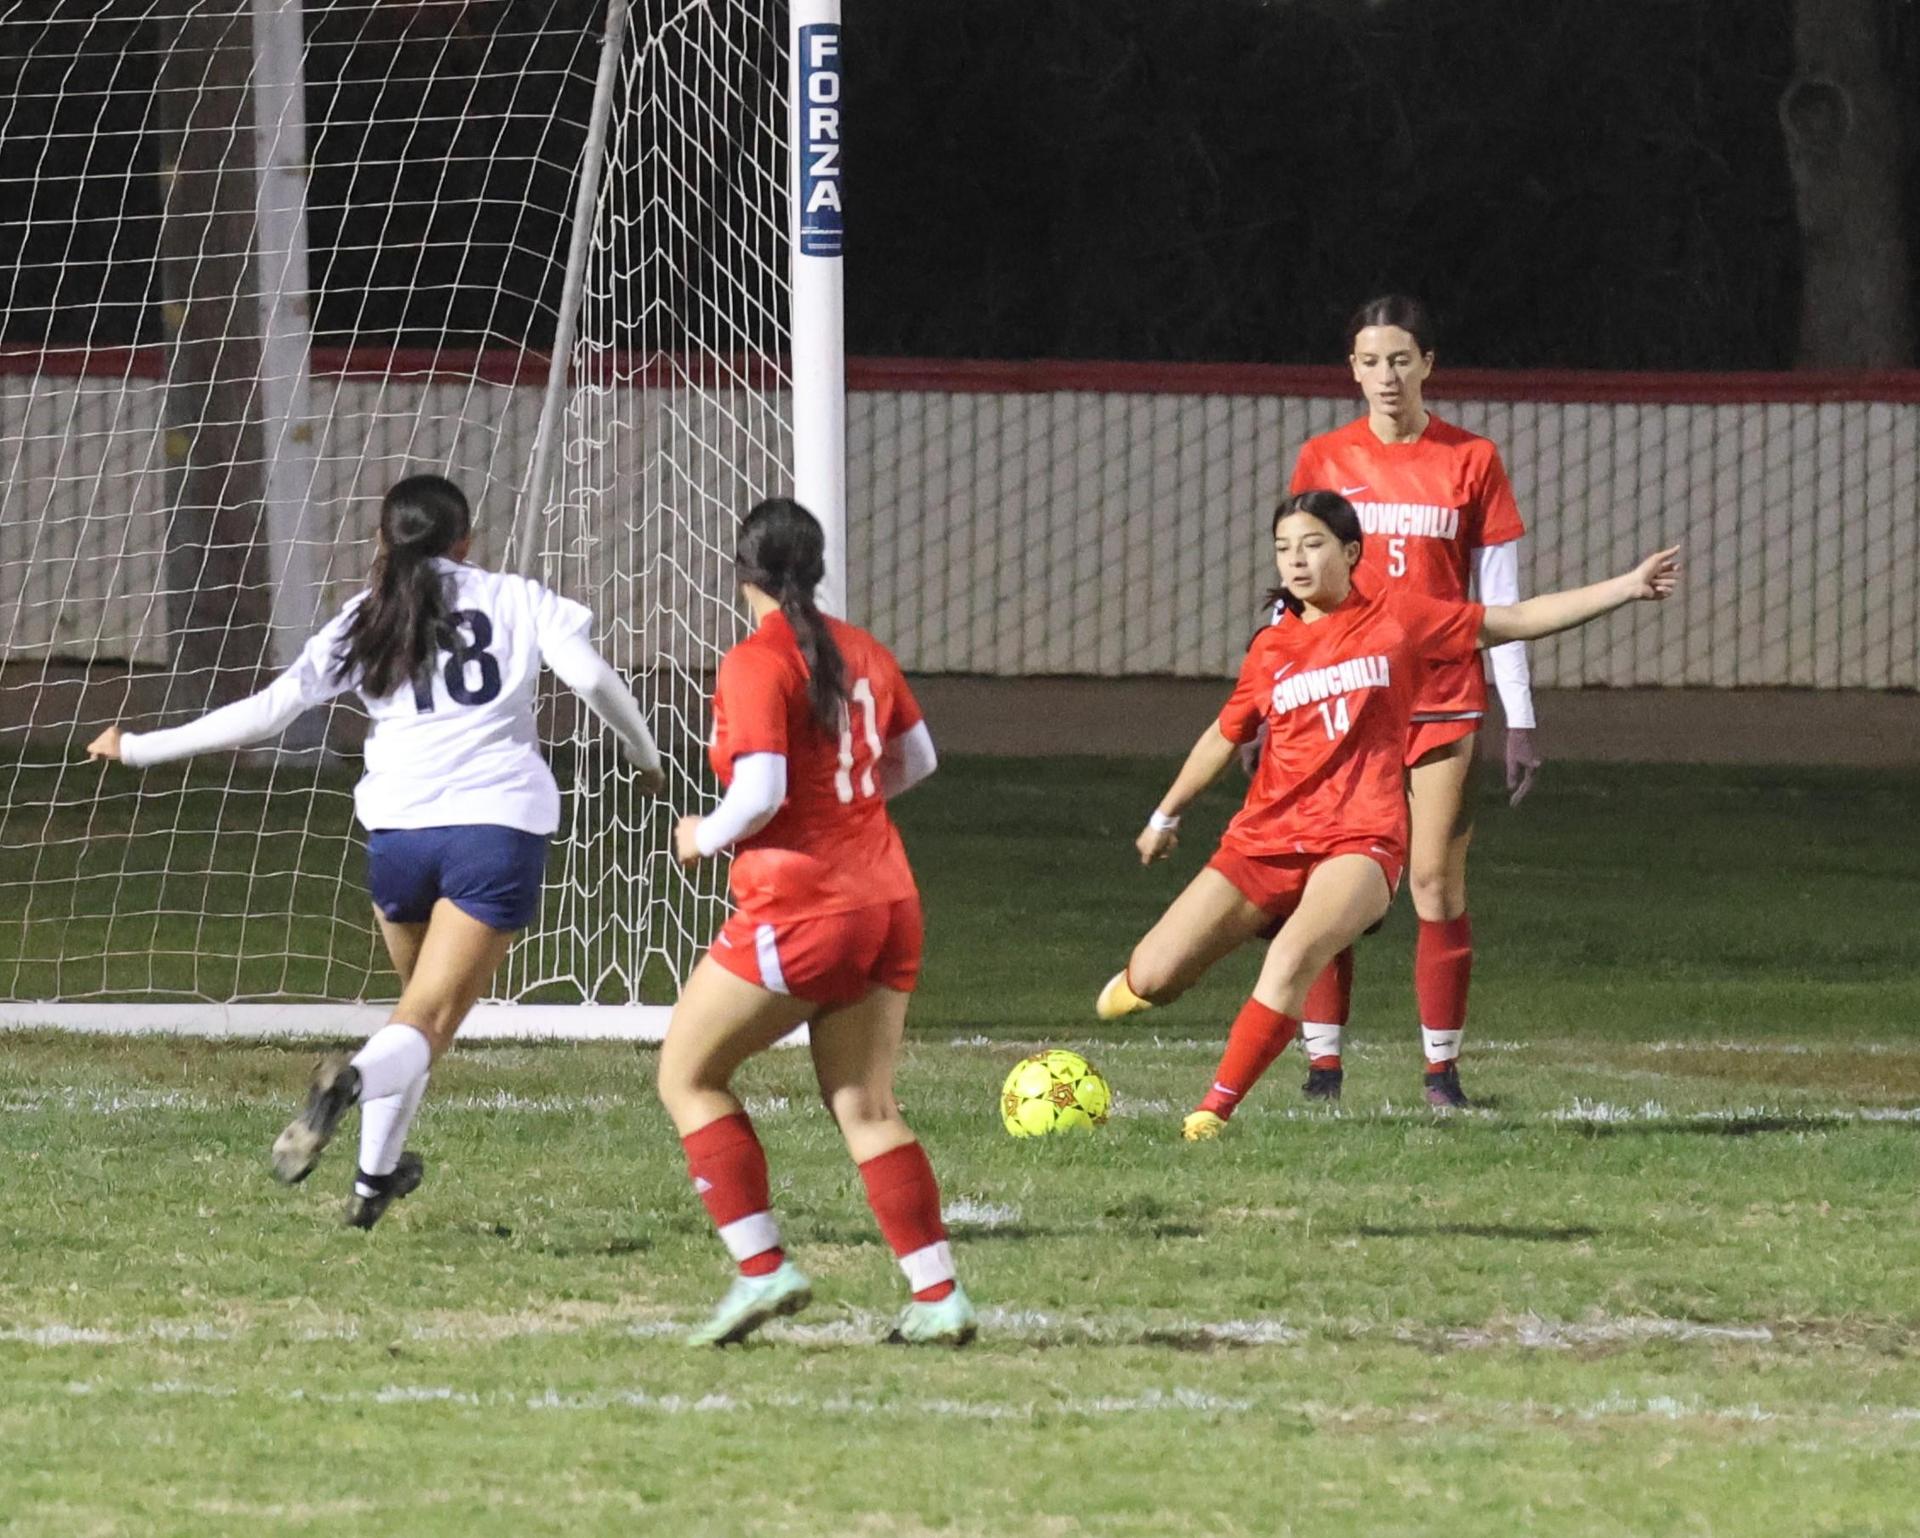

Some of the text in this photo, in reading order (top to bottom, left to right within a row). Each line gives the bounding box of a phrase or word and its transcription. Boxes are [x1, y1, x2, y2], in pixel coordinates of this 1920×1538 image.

[806, 35, 841, 213] FORZA
[1351, 502, 1459, 540] OWCHILLA
[1388, 538, 1406, 577] 5
[1272, 656, 1390, 715] CHOWCHILLA
[834, 677, 882, 804] 11
[1318, 698, 1350, 741] 14
